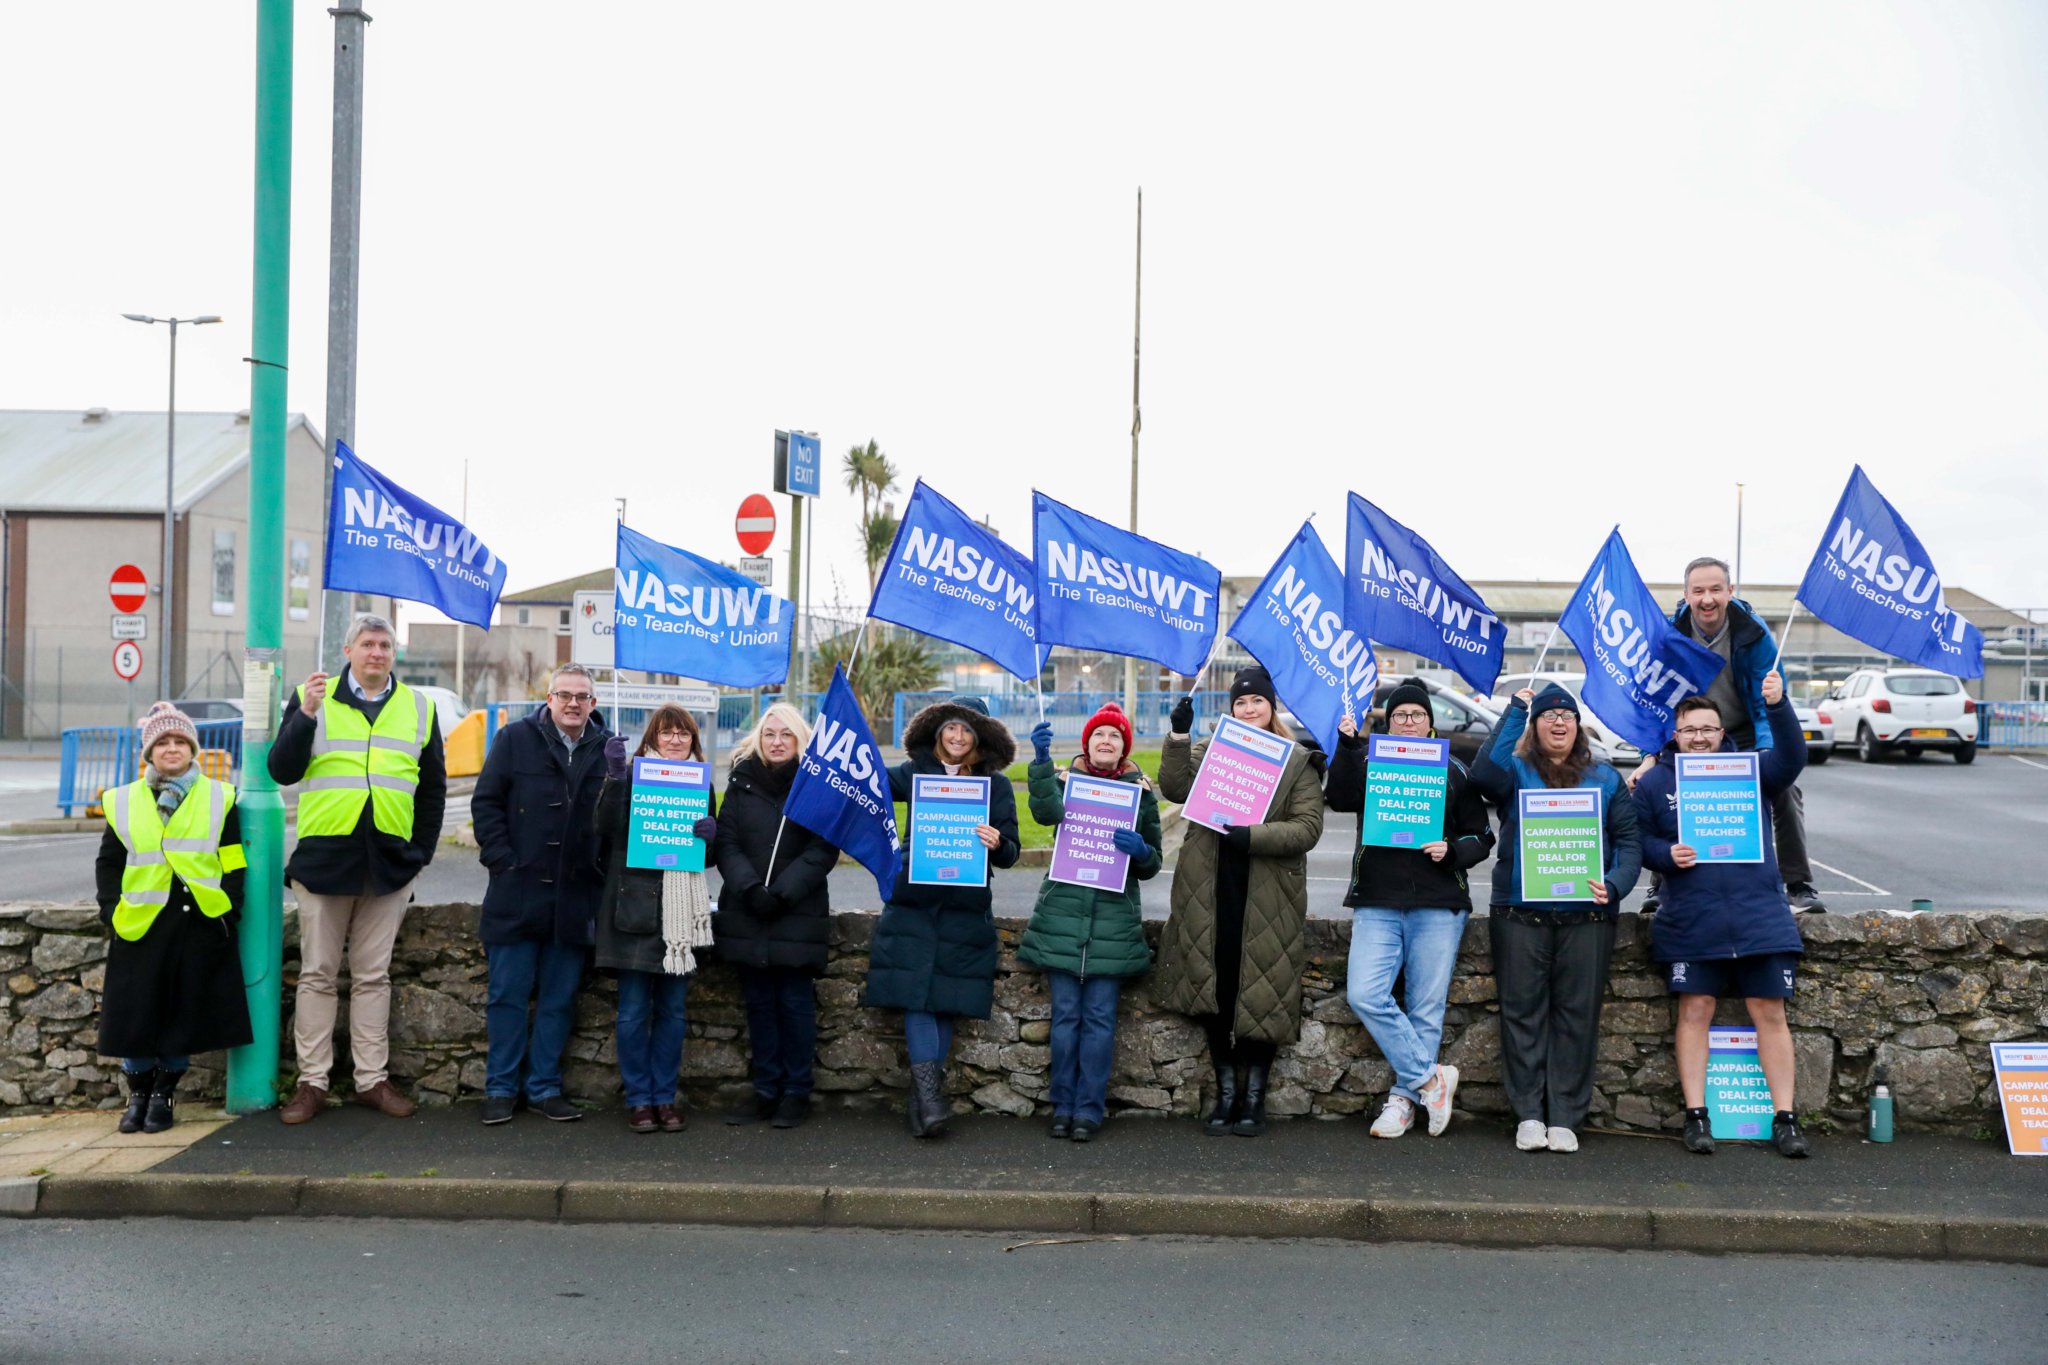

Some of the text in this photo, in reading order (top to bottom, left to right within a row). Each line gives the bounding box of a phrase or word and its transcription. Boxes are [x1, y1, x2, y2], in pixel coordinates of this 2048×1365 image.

[797, 446, 812, 463] NO
[795, 465, 814, 484] EXIT
[344, 529, 378, 547] The
[446, 561, 490, 592] Union
[902, 526, 1035, 616] NASUW
[1048, 540, 1212, 617] NASUWT
[1362, 538, 1498, 640] NASUWT
[1823, 551, 1844, 580] The
[1850, 575, 1929, 620] Teachers'
[615, 567, 781, 627] NASUWT
[899, 564, 1036, 640] The Teachers' Unio
[1048, 582, 1204, 632] The Teachers' Union
[1361, 578, 1390, 598] The
[1442, 628, 1487, 655] Union
[643, 614, 724, 643] Teachers'
[730, 630, 778, 646] Union
[1272, 564, 1377, 700] NASUW
[1264, 596, 1290, 626] The
[1292, 623, 1344, 687] Teachers'
[123, 652, 131, 668] 5
[1210, 752, 1275, 783] CAMPAIGNING
[1207, 764, 1269, 795] FOR A BETTER
[1368, 771, 1445, 785] CAMPAIGNING
[827, 767, 884, 816] Teachers'
[1211, 779, 1255, 803] DEAL FOR
[1369, 785, 1442, 798] FOR A BETTER
[1682, 791, 1755, 799] CAMPAIGNING
[633, 794, 706, 808] CAMPAIGNING
[1206, 790, 1252, 815] TEACHERS
[1379, 799, 1430, 810] DEAL FOR
[634, 807, 704, 820] FOR A BETTER
[916, 813, 984, 823] CAMPAIGNING
[1065, 811, 1131, 829] CAMPAIGNING
[1377, 812, 1431, 824] TEACHERS
[643, 821, 693, 833] DEAL FOR
[918, 825, 936, 833] FOR
[948, 826, 977, 835] BETTE
[1064, 824, 1083, 833] FOR
[1094, 829, 1115, 839] BETT
[1525, 828, 1597, 836] CAMPAIGNING
[1694, 828, 1746, 837] TEACHERS
[641, 834, 693, 846] TEACHERS
[927, 838, 950, 846] DEAL
[1072, 838, 1116, 852] DEAL FOR
[925, 850, 973, 860] TEACHERS
[1068, 849, 1115, 864] TEACHERS
[1707, 1077, 1729, 1086] FOR
[1742, 1078, 1766, 1086] BETT
[1719, 1091, 1747, 1099] DEAL
[2008, 1094, 2029, 1102] FOR
[1718, 1104, 1774, 1113] TEACHERS
[2021, 1107, 2048, 1115] DEAL
